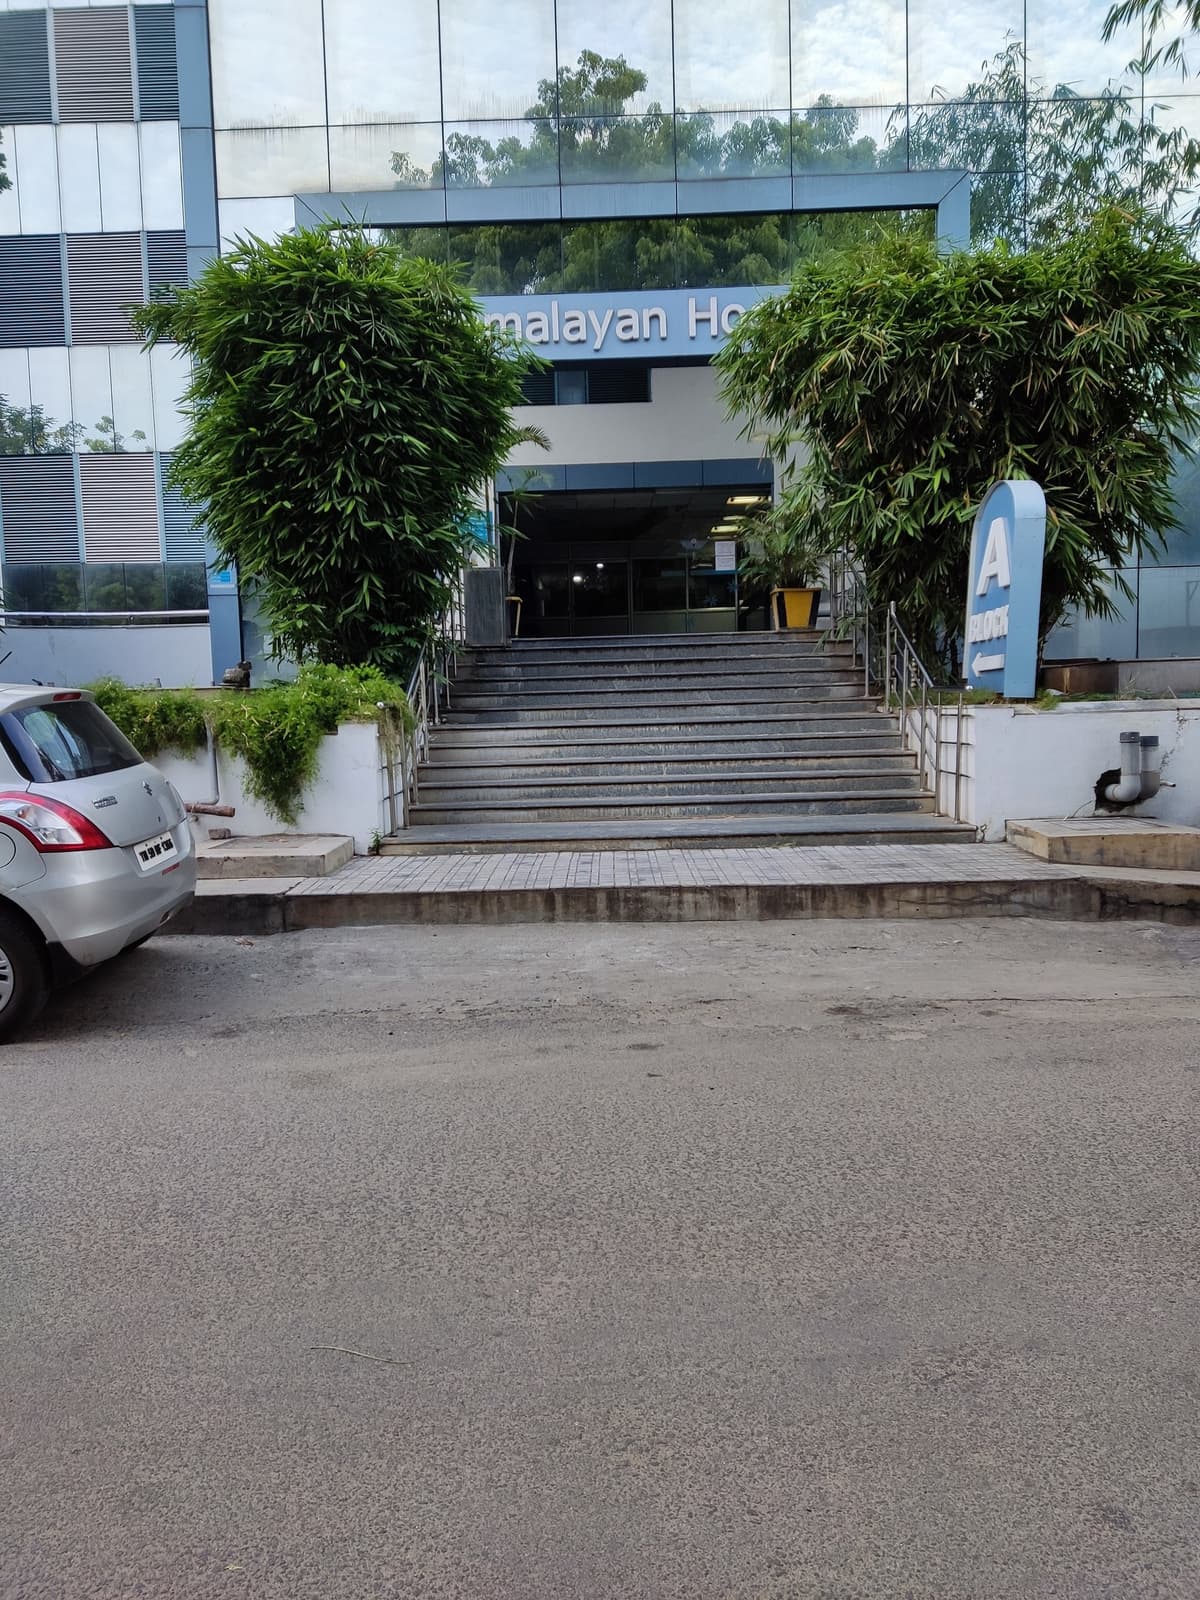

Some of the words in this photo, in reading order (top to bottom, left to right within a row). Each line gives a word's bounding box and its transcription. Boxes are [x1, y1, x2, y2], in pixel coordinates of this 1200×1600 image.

[484, 300, 667, 350] malayan
[688, 296, 747, 338] Ho
[976, 517, 1011, 596] A
[967, 604, 1010, 643] BLOCK
